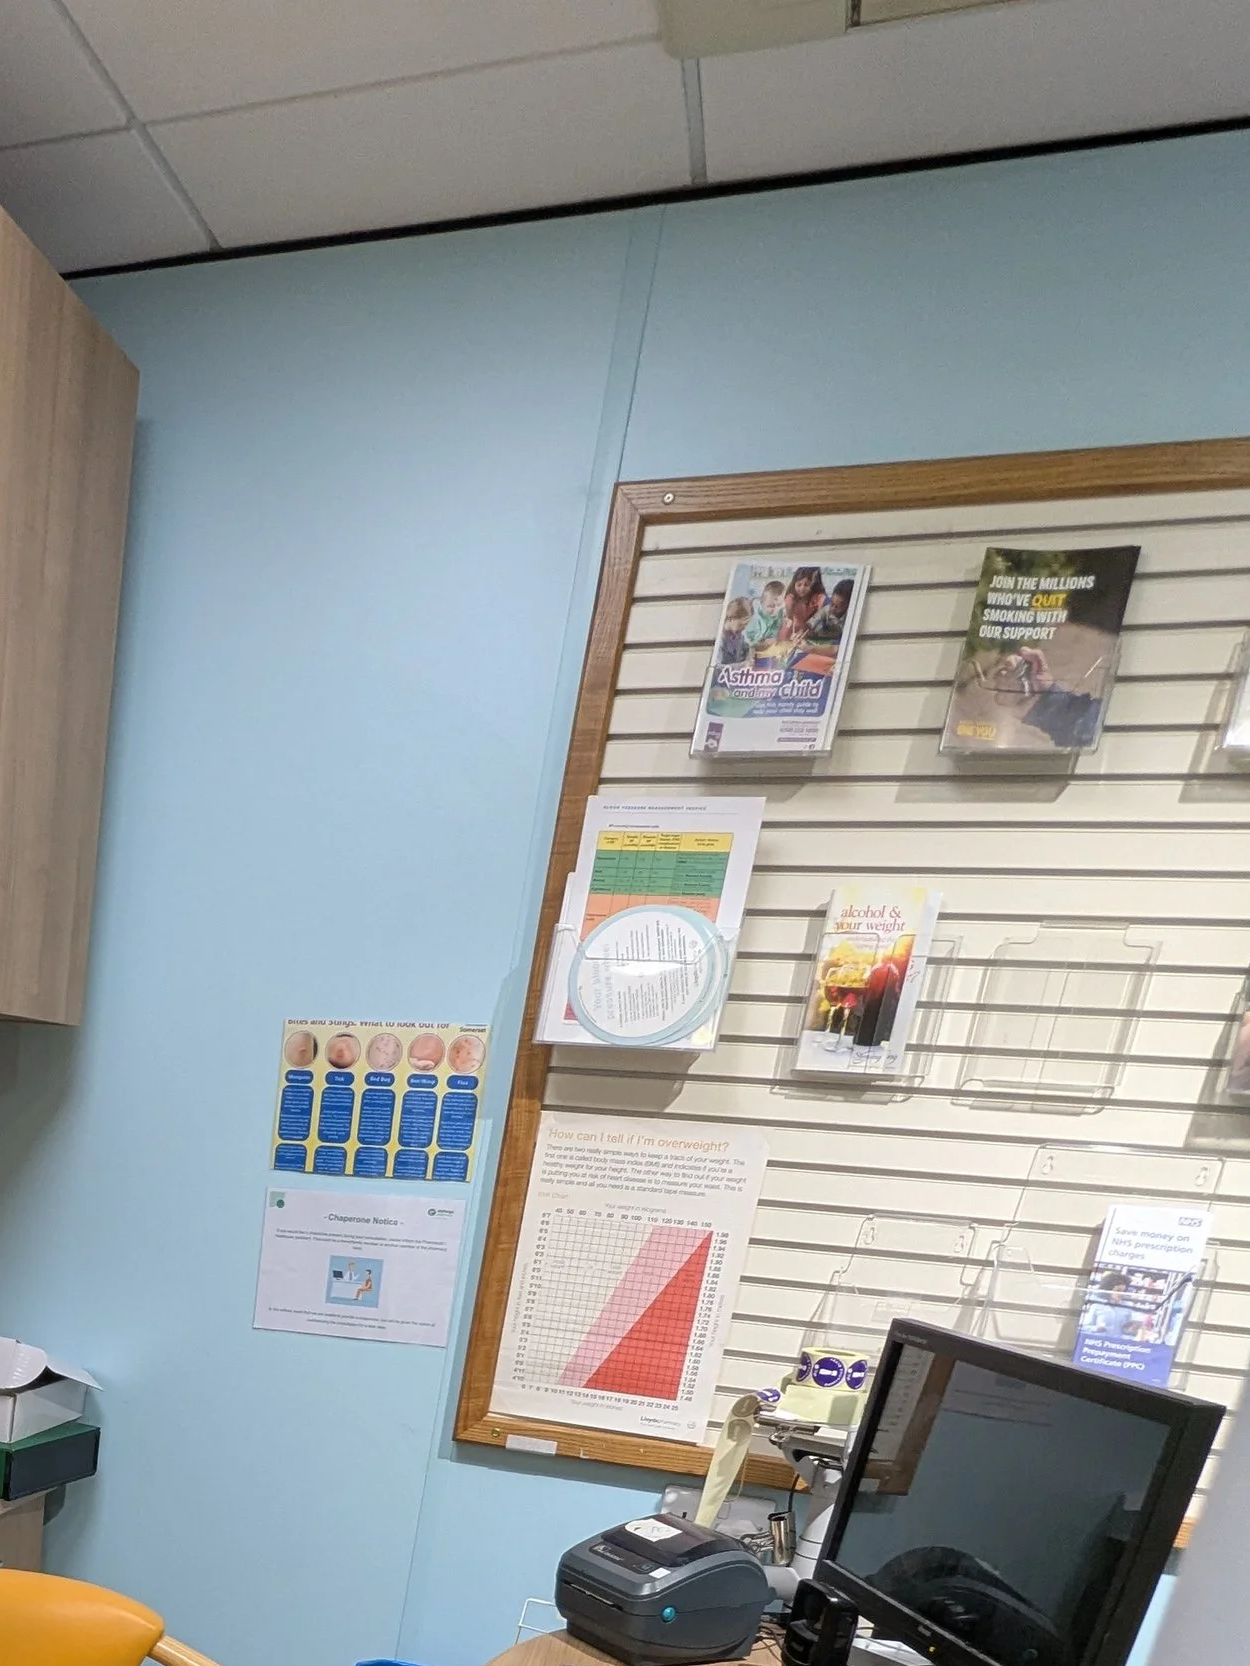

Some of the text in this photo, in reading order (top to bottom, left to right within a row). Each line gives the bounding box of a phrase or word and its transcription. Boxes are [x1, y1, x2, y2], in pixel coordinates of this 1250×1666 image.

[989, 575, 1096, 590] JOIN THE MILLIONS
[986, 592, 1067, 607] WHO'VE QUIT
[982, 609, 1068, 623] SMOKING WITH
[979, 626, 1057, 640] OUR SUPPORT
[718, 666, 784, 686] Asthma
[733, 679, 824, 700] and my child
[841, 905, 902, 919] alcohol &
[835, 919, 906, 932] your weight
[549, 1130, 729, 1153] How can I tell if I'm overweight?
[328, 1213, 398, 1226] Chaperone Notice
[1115, 1227, 1190, 1242] Save money on
[1111, 1238, 1194, 1255] NHS prescription
[1108, 1249, 1145, 1260] charges
[1084, 1338, 1151, 1354] NHS Prescription
[1081, 1347, 1131, 1361] Prepayment
[1080, 1355, 1121, 1368] Certificate
